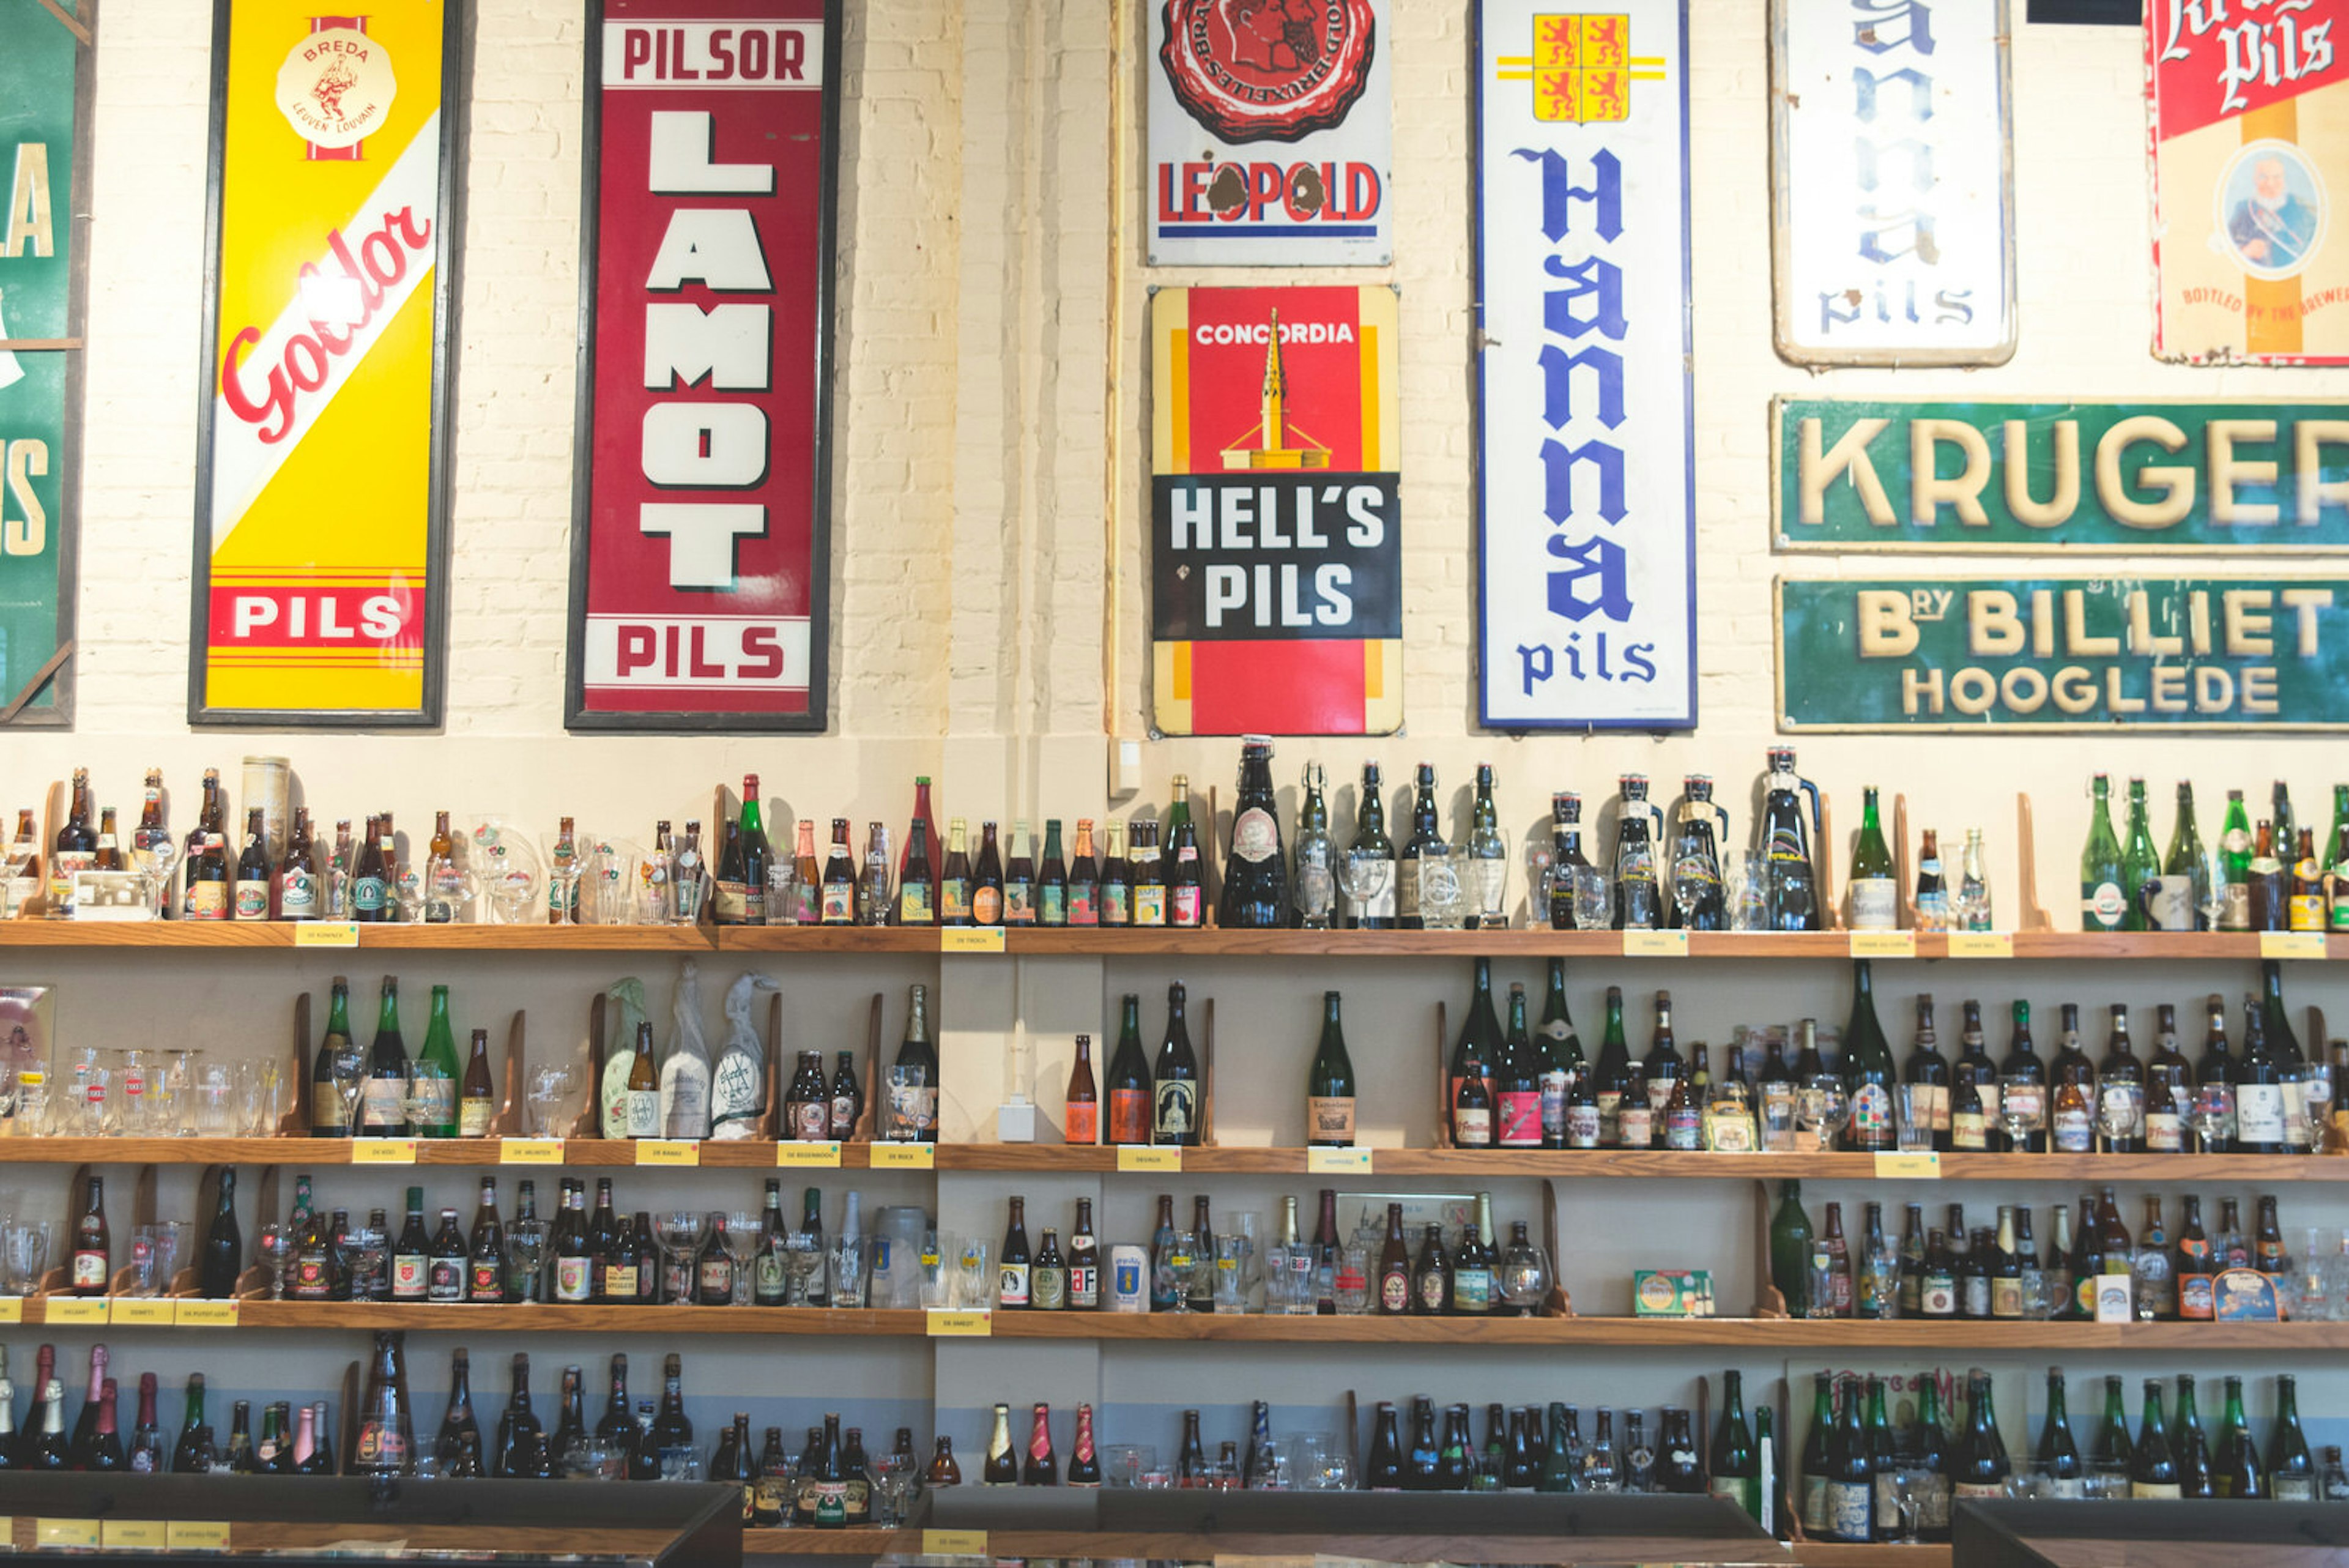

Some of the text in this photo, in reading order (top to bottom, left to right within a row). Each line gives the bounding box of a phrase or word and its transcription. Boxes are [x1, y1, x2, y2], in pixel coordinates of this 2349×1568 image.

[303, 40, 369, 63] BREDA
[623, 29, 805, 80] PILSOR
[1205, 58, 1332, 102] BRUXELLES
[292, 102, 377, 133] LEUVEN LOUVAIN
[1817, 278, 1974, 334] pils
[2182, 286, 2243, 313] BOTTLED
[2246, 303, 2266, 319] BY
[2270, 306, 2296, 324] THE
[639, 110, 776, 592] LAMOT
[1195, 322, 1354, 344] CONCORDIA
[1170, 485, 1385, 549] HELL'S
[233, 596, 402, 639] PILS
[1204, 563, 1353, 628] PILS
[1967, 589, 2334, 658] BILLIET
[616, 625, 785, 679] PILS
[1516, 631, 1657, 697] pils
[1901, 666, 2280, 715] HOOGLEDE
